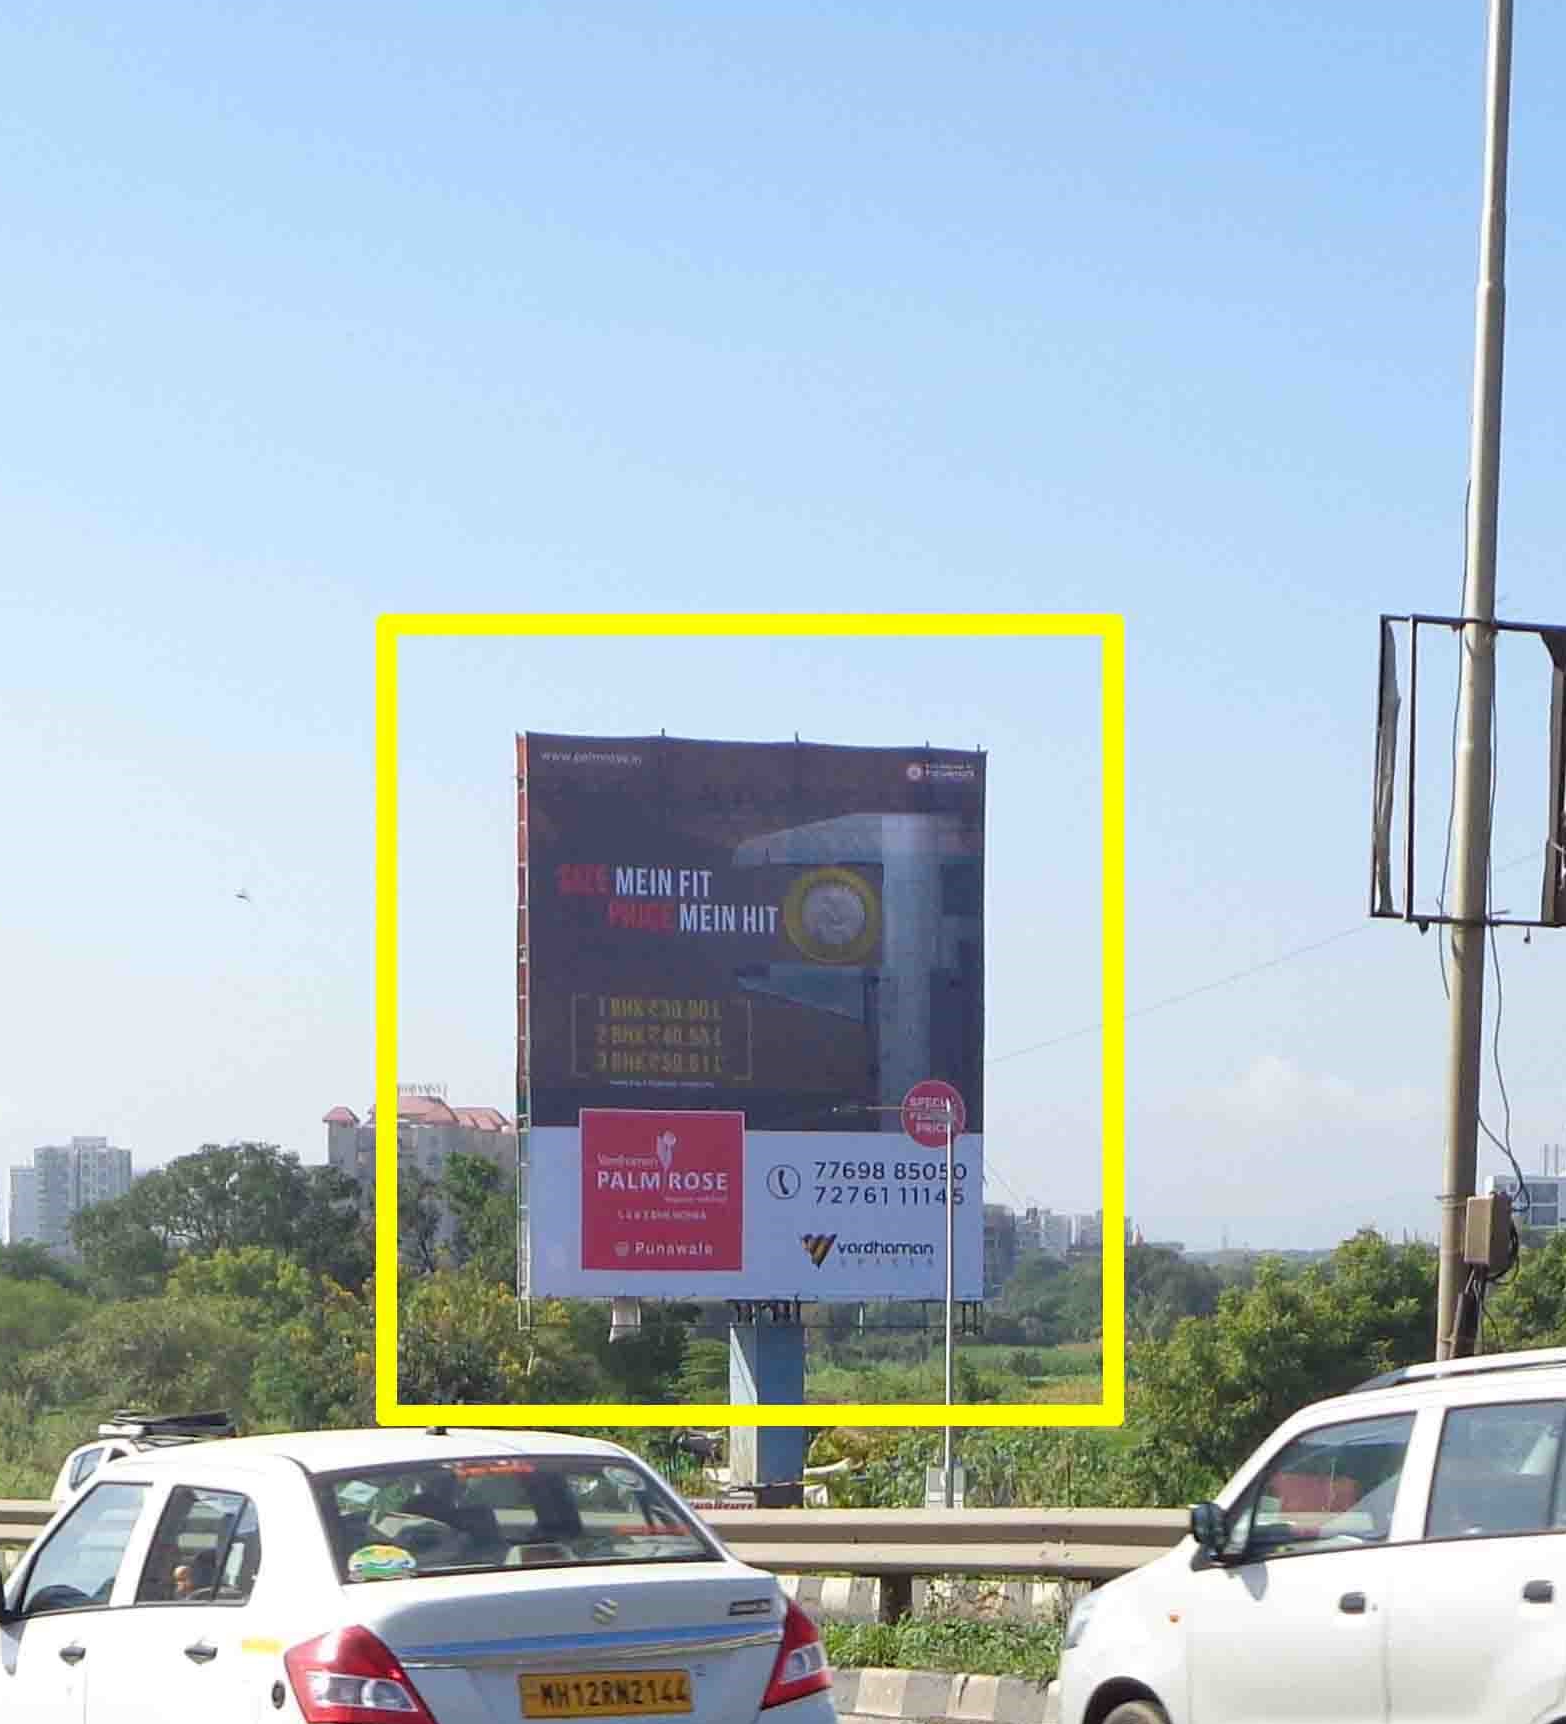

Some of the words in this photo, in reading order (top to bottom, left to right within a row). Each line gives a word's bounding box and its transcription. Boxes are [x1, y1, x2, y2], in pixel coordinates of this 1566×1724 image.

[615, 867, 672, 896] MEIN
[679, 869, 713, 897] FIT
[679, 903, 735, 932] MEIN
[742, 905, 779, 933] HIT
[597, 1170, 660, 1190] PALM
[669, 1172, 728, 1192] ROSE
[814, 1161, 885, 1180] 77698
[894, 1162, 967, 1181] 85050
[814, 1186, 889, 1205] 72761
[898, 1187, 965, 1206] 11145
